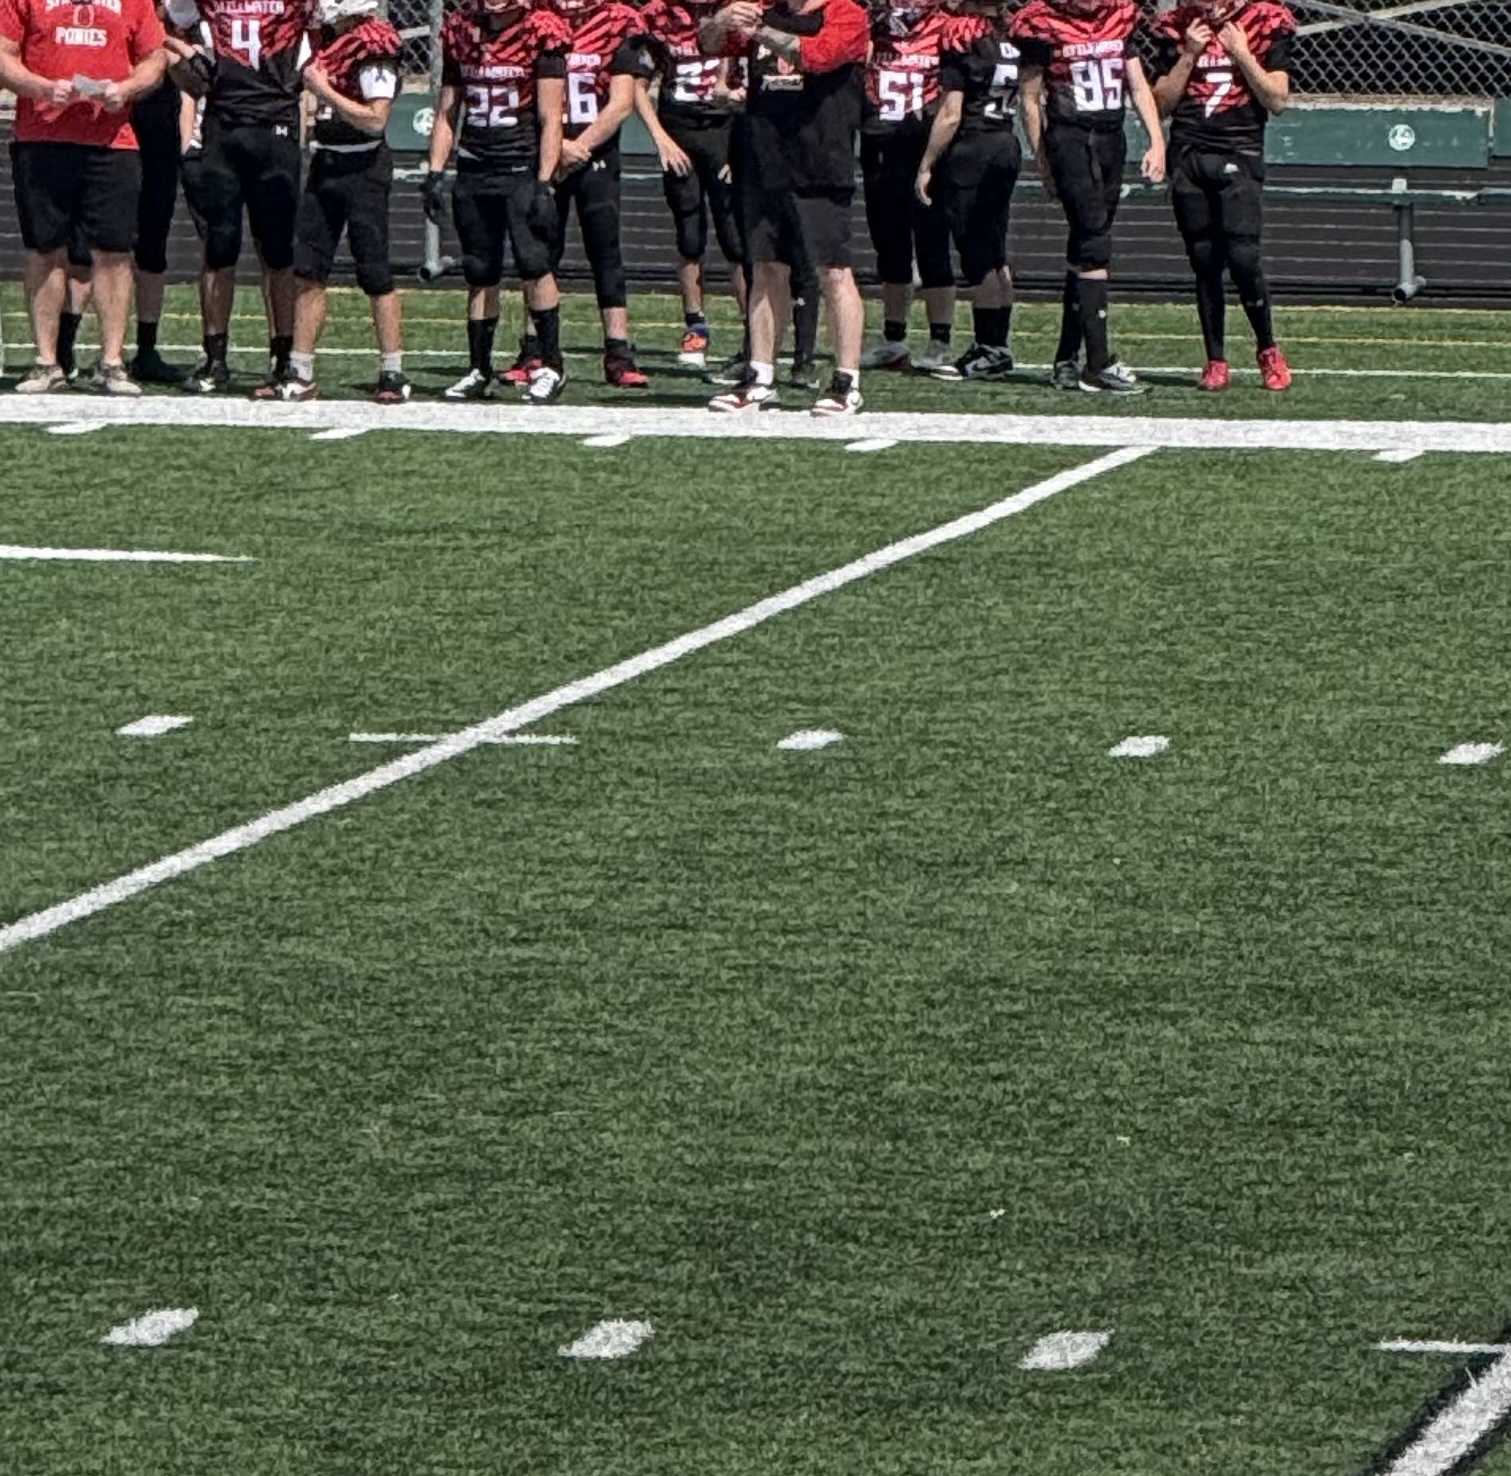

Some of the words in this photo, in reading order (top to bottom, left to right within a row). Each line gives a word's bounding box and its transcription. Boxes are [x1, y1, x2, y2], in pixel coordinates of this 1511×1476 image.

[232, 20, 262, 71] 4
[879, 70, 924, 121] 51
[1205, 73, 1233, 119] 7
